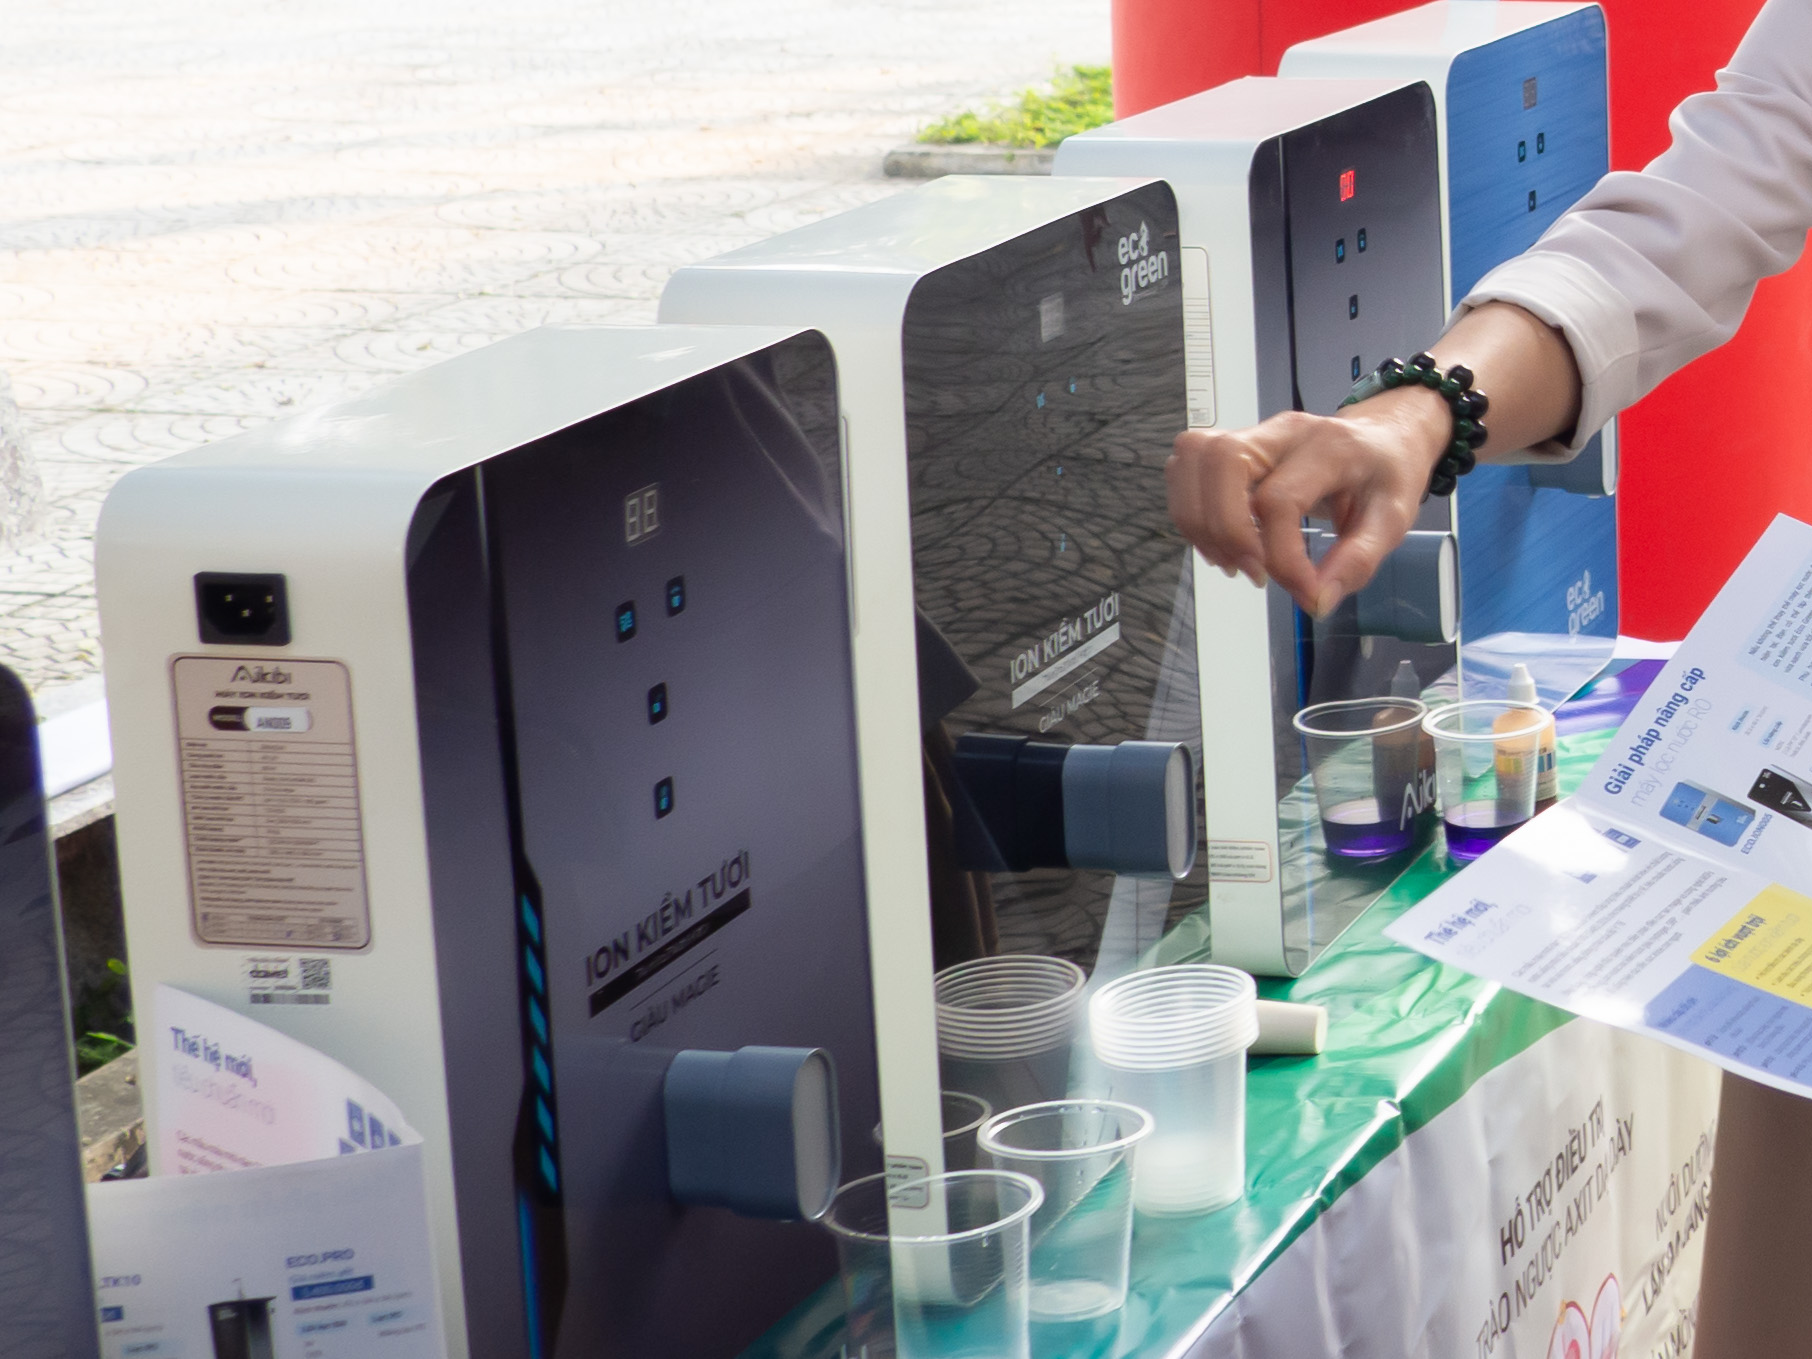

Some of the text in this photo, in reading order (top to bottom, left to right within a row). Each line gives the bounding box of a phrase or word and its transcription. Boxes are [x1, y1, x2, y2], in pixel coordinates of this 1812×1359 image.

[1121, 251, 1168, 306] green
[1010, 644, 1040, 684] ION
[1083, 591, 1120, 635] TƯƠI
[1568, 591, 1604, 645] green
[1604, 667, 1706, 795] Giải pháp nâng cấp
[585, 931, 630, 987] ION
[697, 849, 750, 908] TƯƠI
[1564, 1175, 1593, 1246] AXIT
